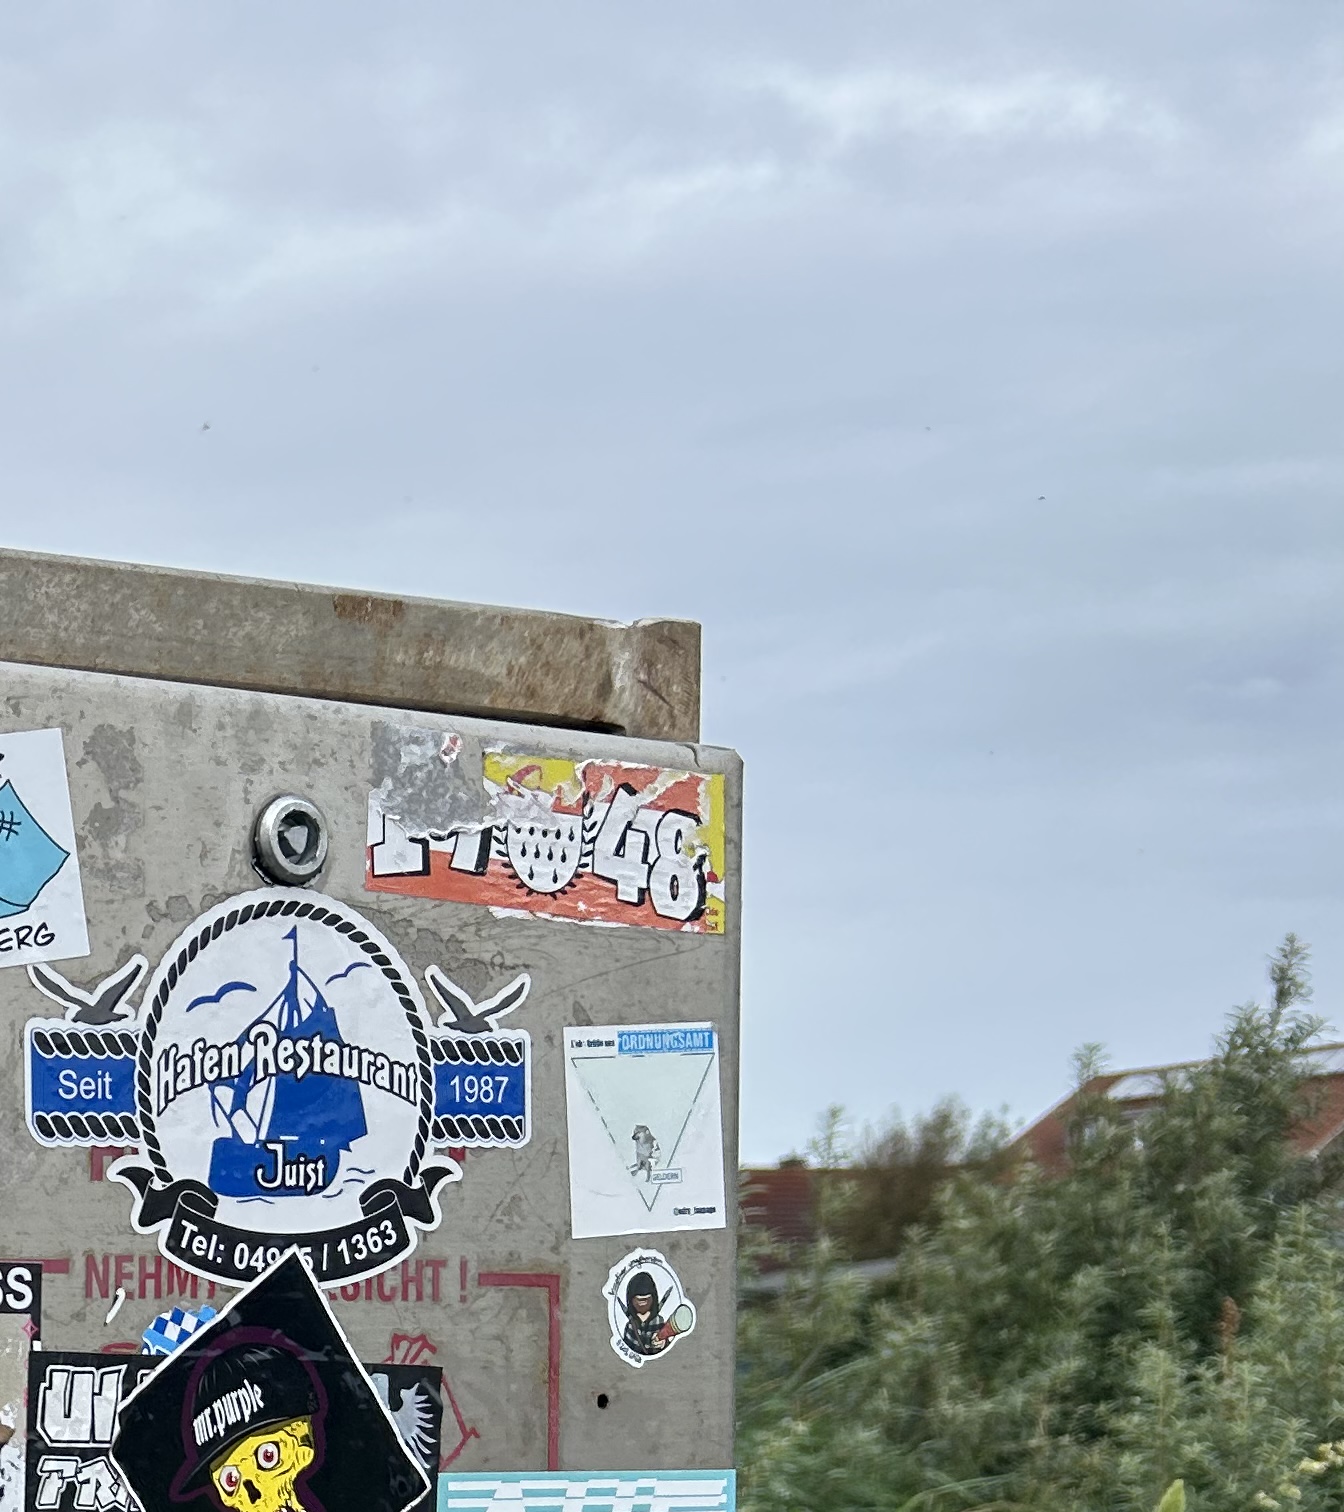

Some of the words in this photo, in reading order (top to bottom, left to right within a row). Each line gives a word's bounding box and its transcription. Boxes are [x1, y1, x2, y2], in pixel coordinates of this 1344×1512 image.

[620, 1031, 711, 1051] ORDNUNGSAMT
[58, 1070, 112, 1099] Seit
[158, 1040, 246, 1115] Hafen
[249, 1024, 417, 1103] Restaurant
[450, 1075, 509, 1104] 1987
[257, 1142, 325, 1189] Juist
[179, 1219, 224, 1264] Tel:
[233, 1241, 313, 1274] 0495
[337, 1219, 398, 1266] 1363
[192, 1379, 265, 1446] mr.purple
